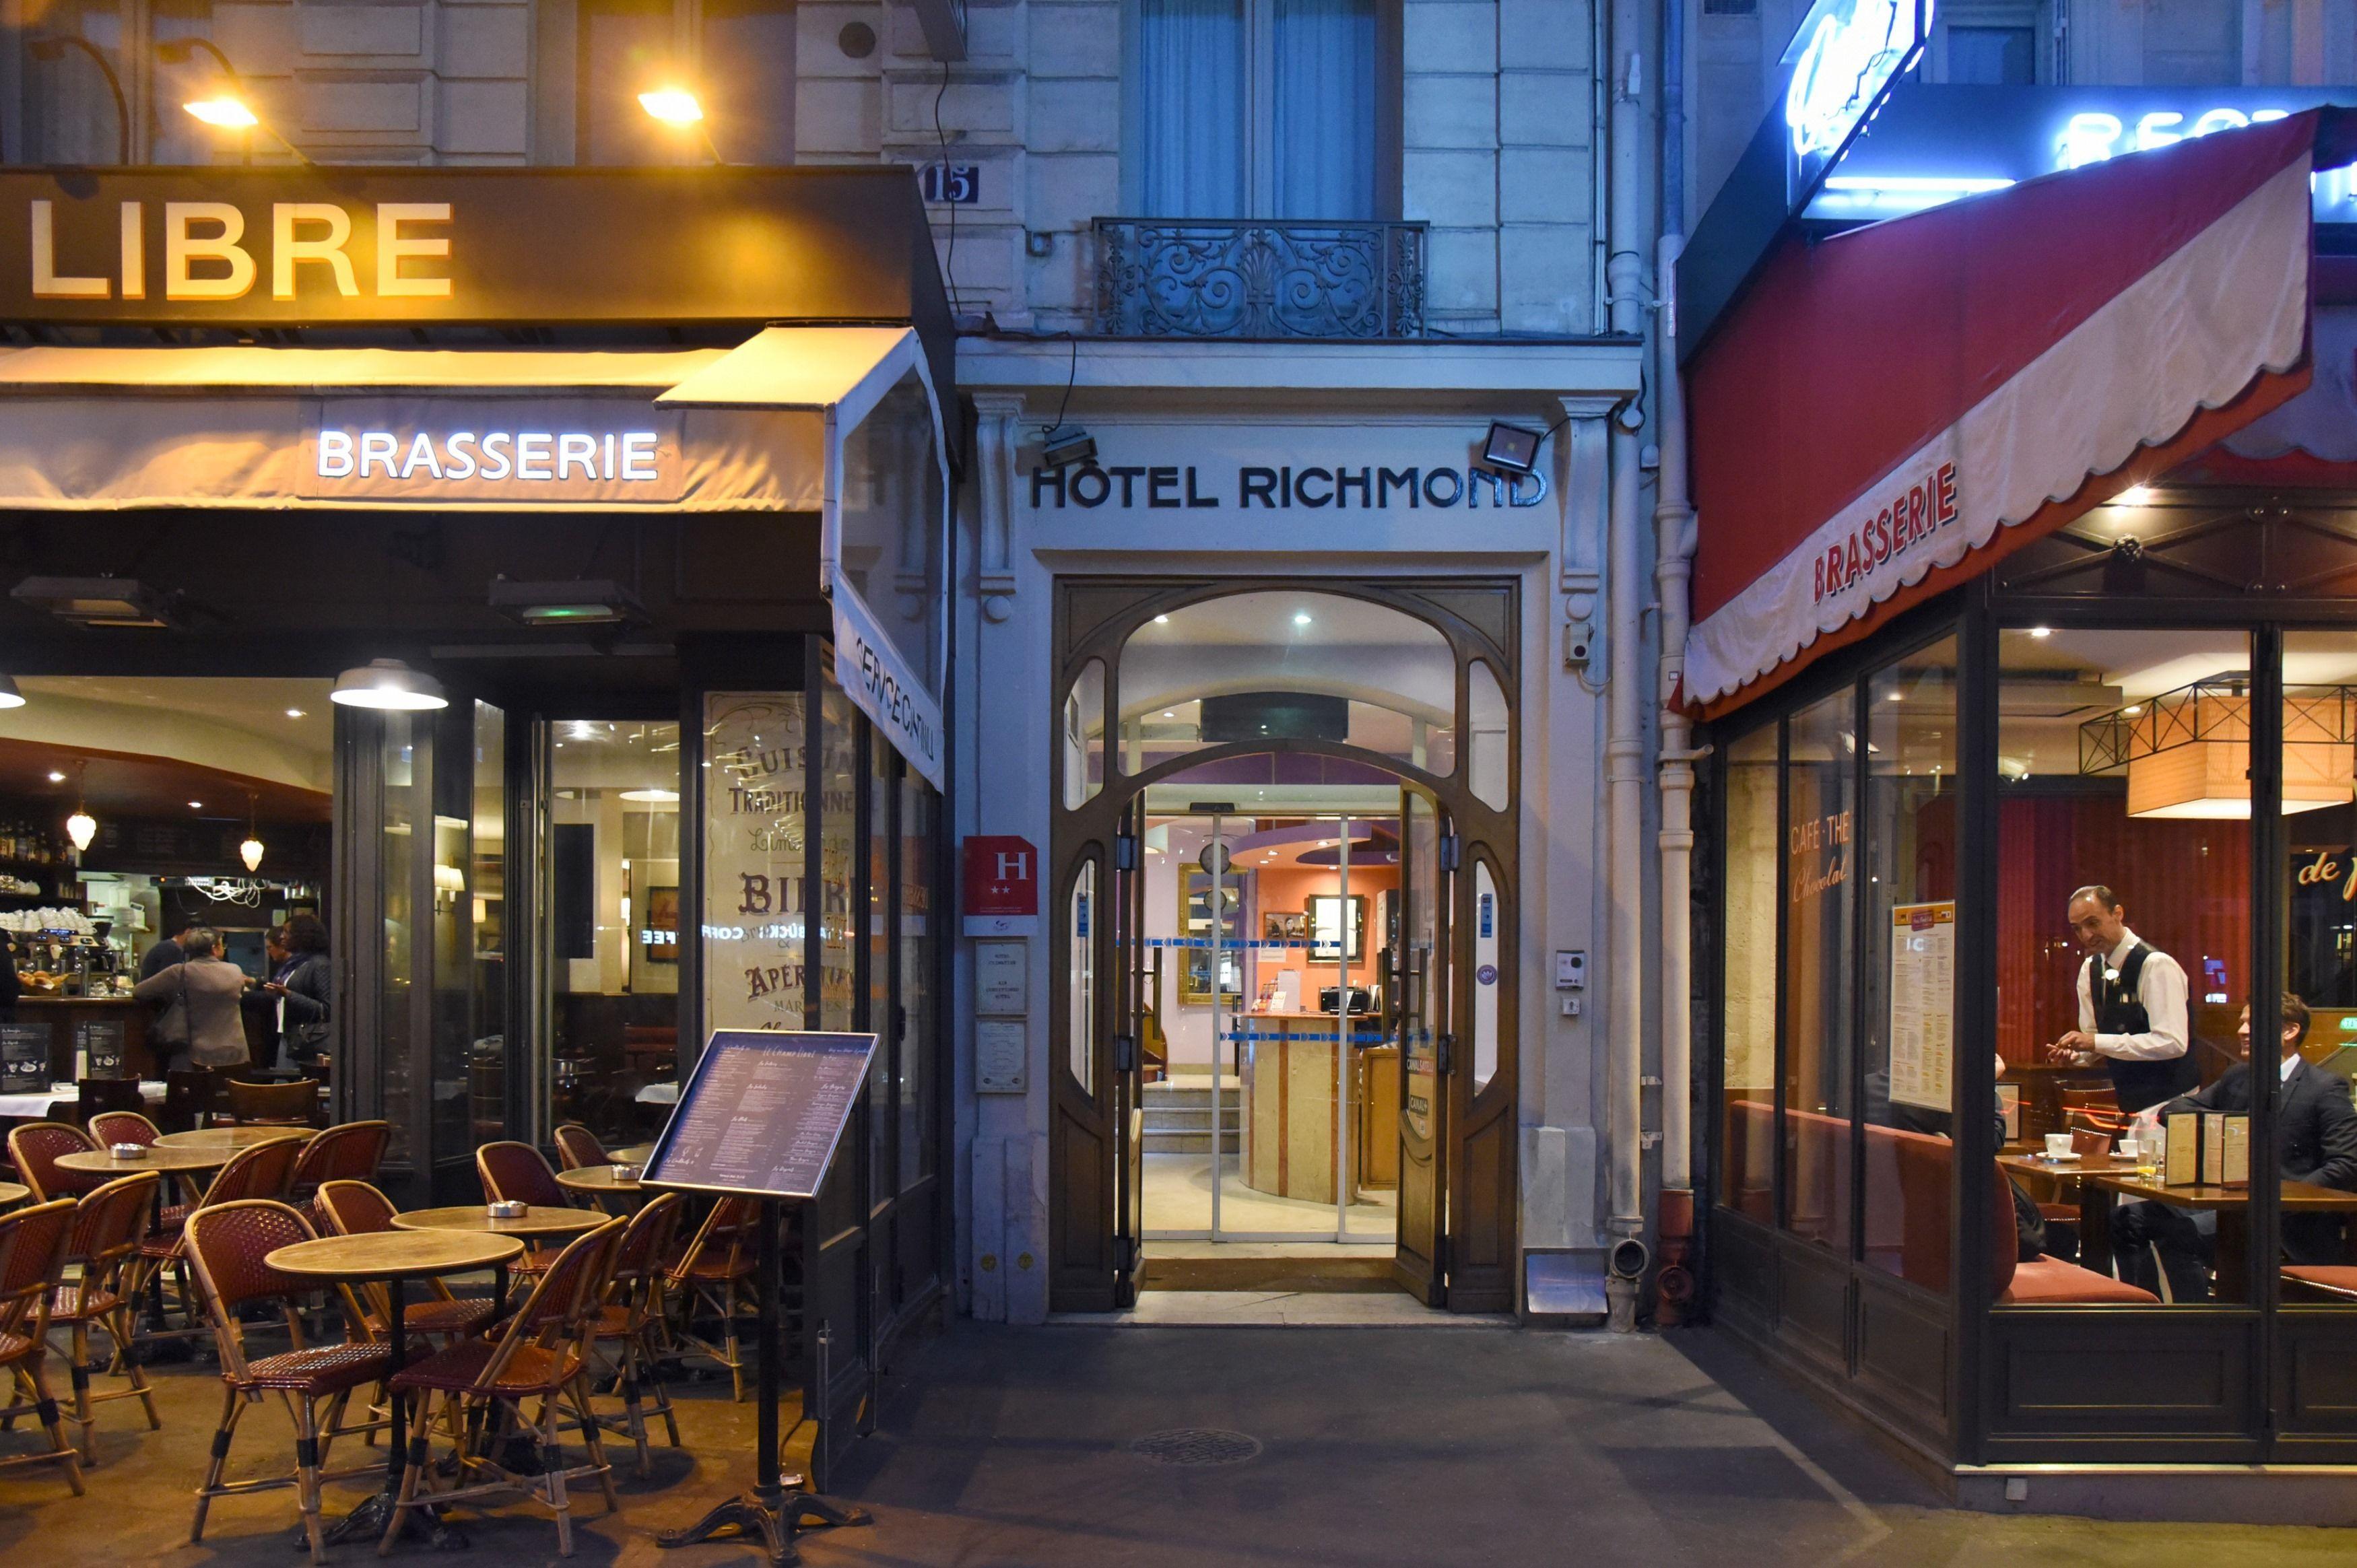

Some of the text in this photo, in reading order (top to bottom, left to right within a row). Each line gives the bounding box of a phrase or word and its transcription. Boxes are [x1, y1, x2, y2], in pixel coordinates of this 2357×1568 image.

[934, 166, 970, 201] 15
[32, 200, 454, 301] LIBRE
[318, 430, 659, 480] BRASSERIE
[1238, 466, 1549, 509] RICHMOND
[1813, 460, 1958, 606] BRASSERIE
[994, 852, 1030, 880] H
[1793, 852, 1848, 903] Chocolat
[2298, 852, 2342, 886] de
